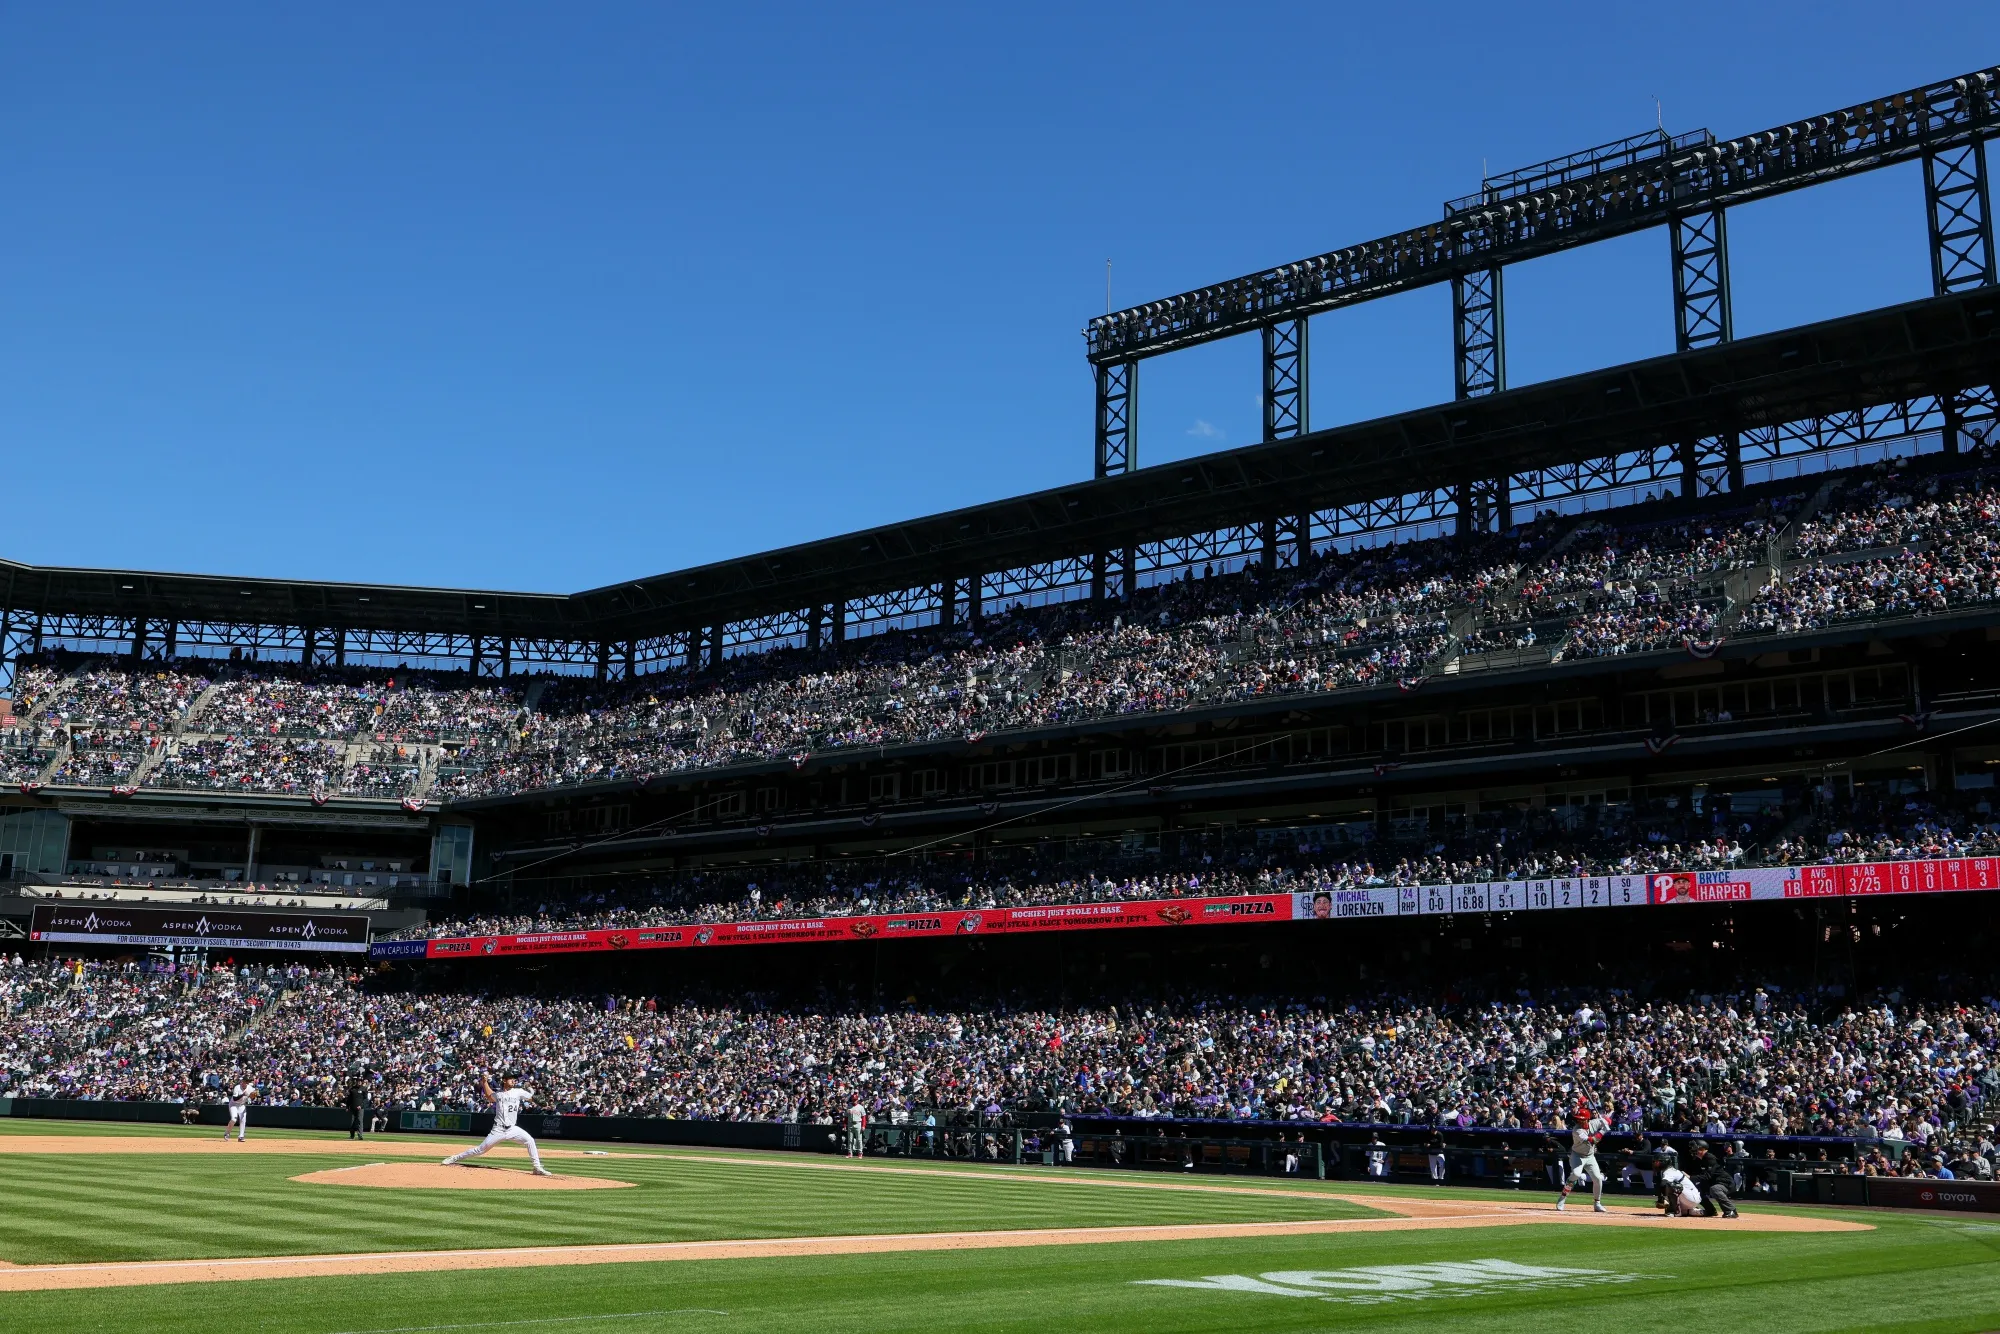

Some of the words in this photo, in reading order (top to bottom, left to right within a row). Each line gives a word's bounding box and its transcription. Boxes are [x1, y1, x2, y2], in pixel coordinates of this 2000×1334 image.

[1789, 868, 1796, 879] 3
[1810, 868, 1826, 879] AVG
[1853, 866, 1875, 877] H/AB
[1898, 864, 1910, 874] 2B
[1923, 863, 1934, 873] 3B
[1948, 862, 1960, 872] HR
[1974, 860, 1990, 870] RBI
[1699, 871, 1730, 885] BRYCE
[1806, 879, 1833, 894] .120
[1849, 877, 1881, 893] 3/25
[1901, 876, 1909, 890] 0
[1926, 874, 1934, 889] 0
[1952, 873, 1958, 887] 1
[1979, 872, 1987, 887] 3
[1429, 888, 1441, 897] W-L
[1463, 886, 1476, 895] ERA
[1503, 885, 1510, 893] IP
[1536, 883, 1544, 892] ER
[1561, 881, 1571, 891] HR
[1590, 880, 1599, 889] BB
[1621, 878, 1631, 887] SO
[1699, 884, 1747, 900] HARPER
[1786, 882, 1800, 895] 1B
[1336, 891, 1371, 902] MICHAEL
[1403, 889, 1413, 899] 24
[1428, 898, 1444, 911] 0-0
[1457, 895, 1484, 910] 16.88
[1498, 894, 1514, 908] 5.1
[1534, 893, 1547, 907] 10
[1563, 892, 1570, 905] 2
[1592, 890, 1598, 904] 2
[1623, 889, 1630, 903] 5
[1231, 902, 1275, 915] PIZZA
[1336, 902, 1384, 916] LORENZEN
[1401, 902, 1416, 912] RHP
[1012, 910, 1046, 918] ROCKIES
[1047, 909, 1065, 918] JUST
[50, 918, 83, 926] ASPEN
[162, 922, 194, 930] ASPEN
[211, 923, 242, 931] VODKA
[908, 918, 942, 930] PIZZA
[1063, 917, 1113, 925] TOMORROW
[269, 926, 300, 934] ASPEN
[318, 927, 348, 935] VODKA
[765, 924, 779, 932] JUST
[181, 937, 206, 945] SECURITY
[655, 932, 682, 942] PIZZA
[372, 948, 386, 956] DAN
[388, 946, 409, 954] CAPLIS
[411, 945, 426, 954] LAW
[449, 943, 471, 952] PIZZA
[413, 1114, 460, 1129] bet365
[1938, 1193, 1977, 1202] TOYOTA
[1126, 1258, 1616, 1298] YORK
